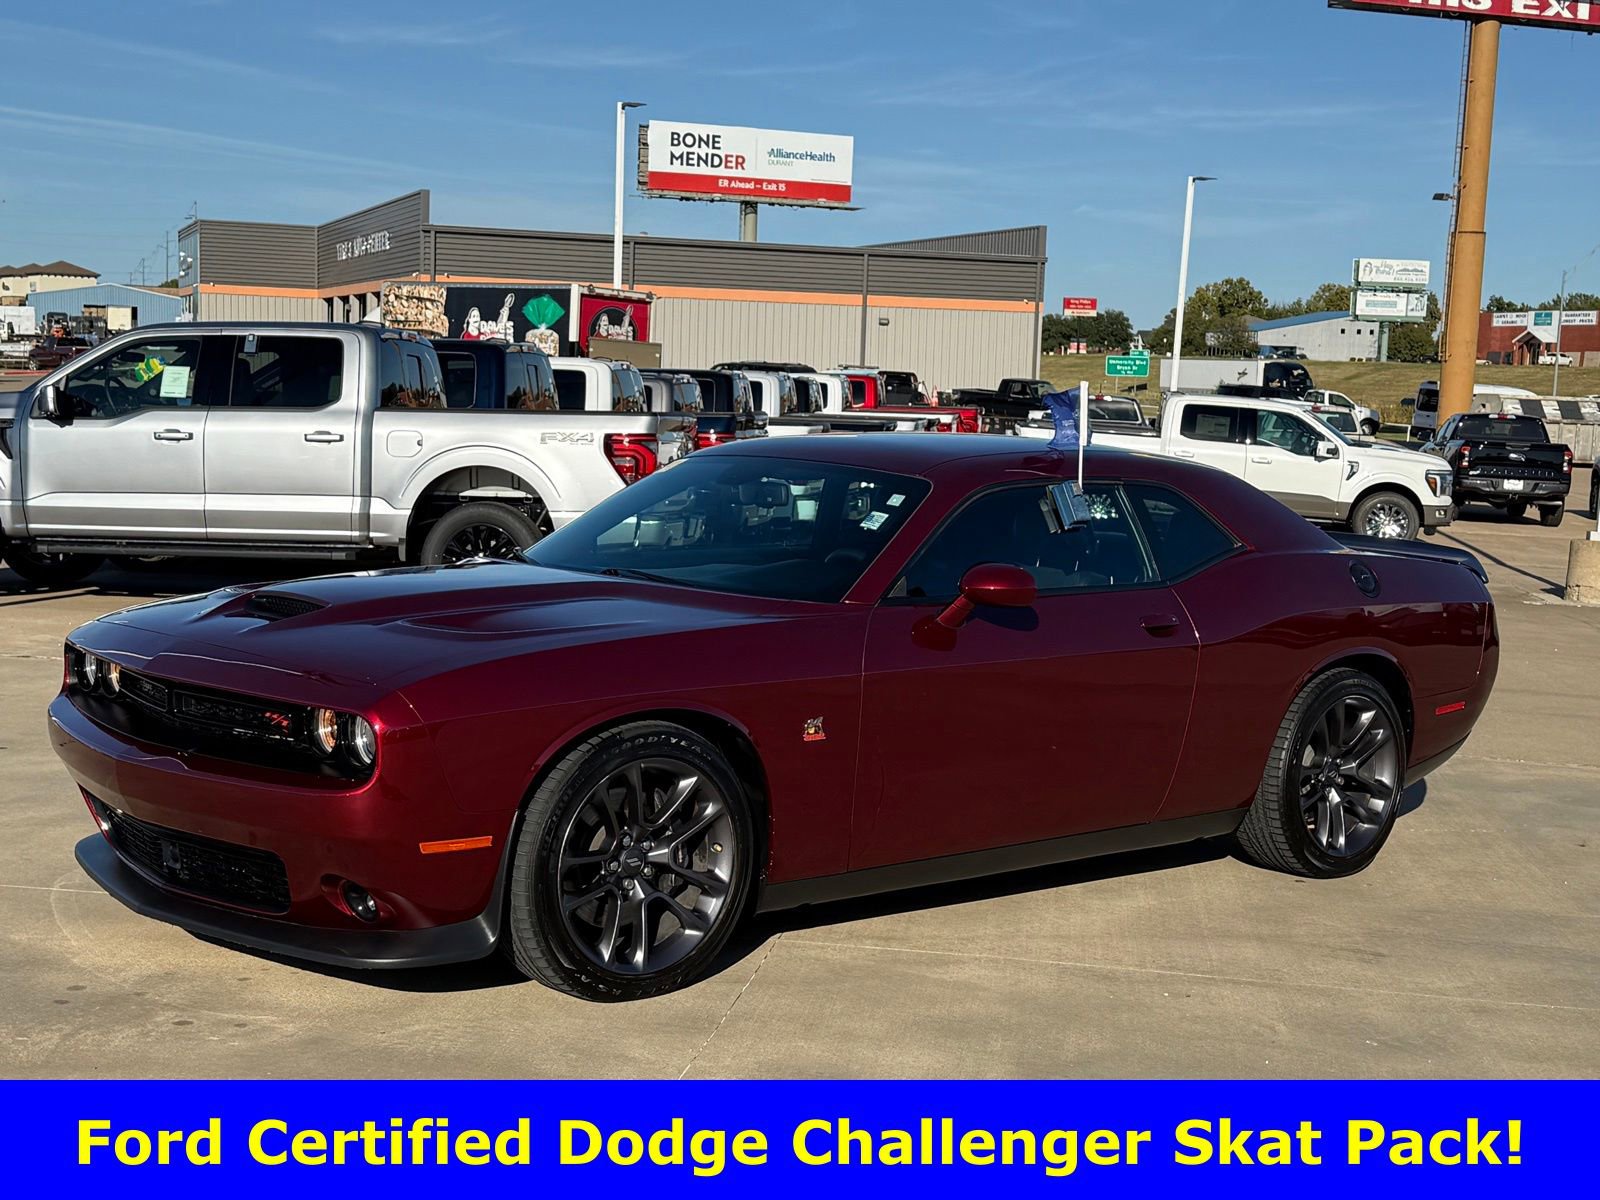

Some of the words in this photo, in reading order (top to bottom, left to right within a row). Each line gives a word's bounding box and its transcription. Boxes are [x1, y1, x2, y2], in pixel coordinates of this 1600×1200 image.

[670, 131, 722, 150] BONE
[669, 150, 746, 171] MENDER
[768, 147, 836, 163] AllianceHealth
[718, 178, 730, 188] ER
[730, 179, 755, 190] Ahead
[762, 181, 777, 191] Exit
[778, 182, 786, 192] 15
[540, 431, 594, 444] FX4
